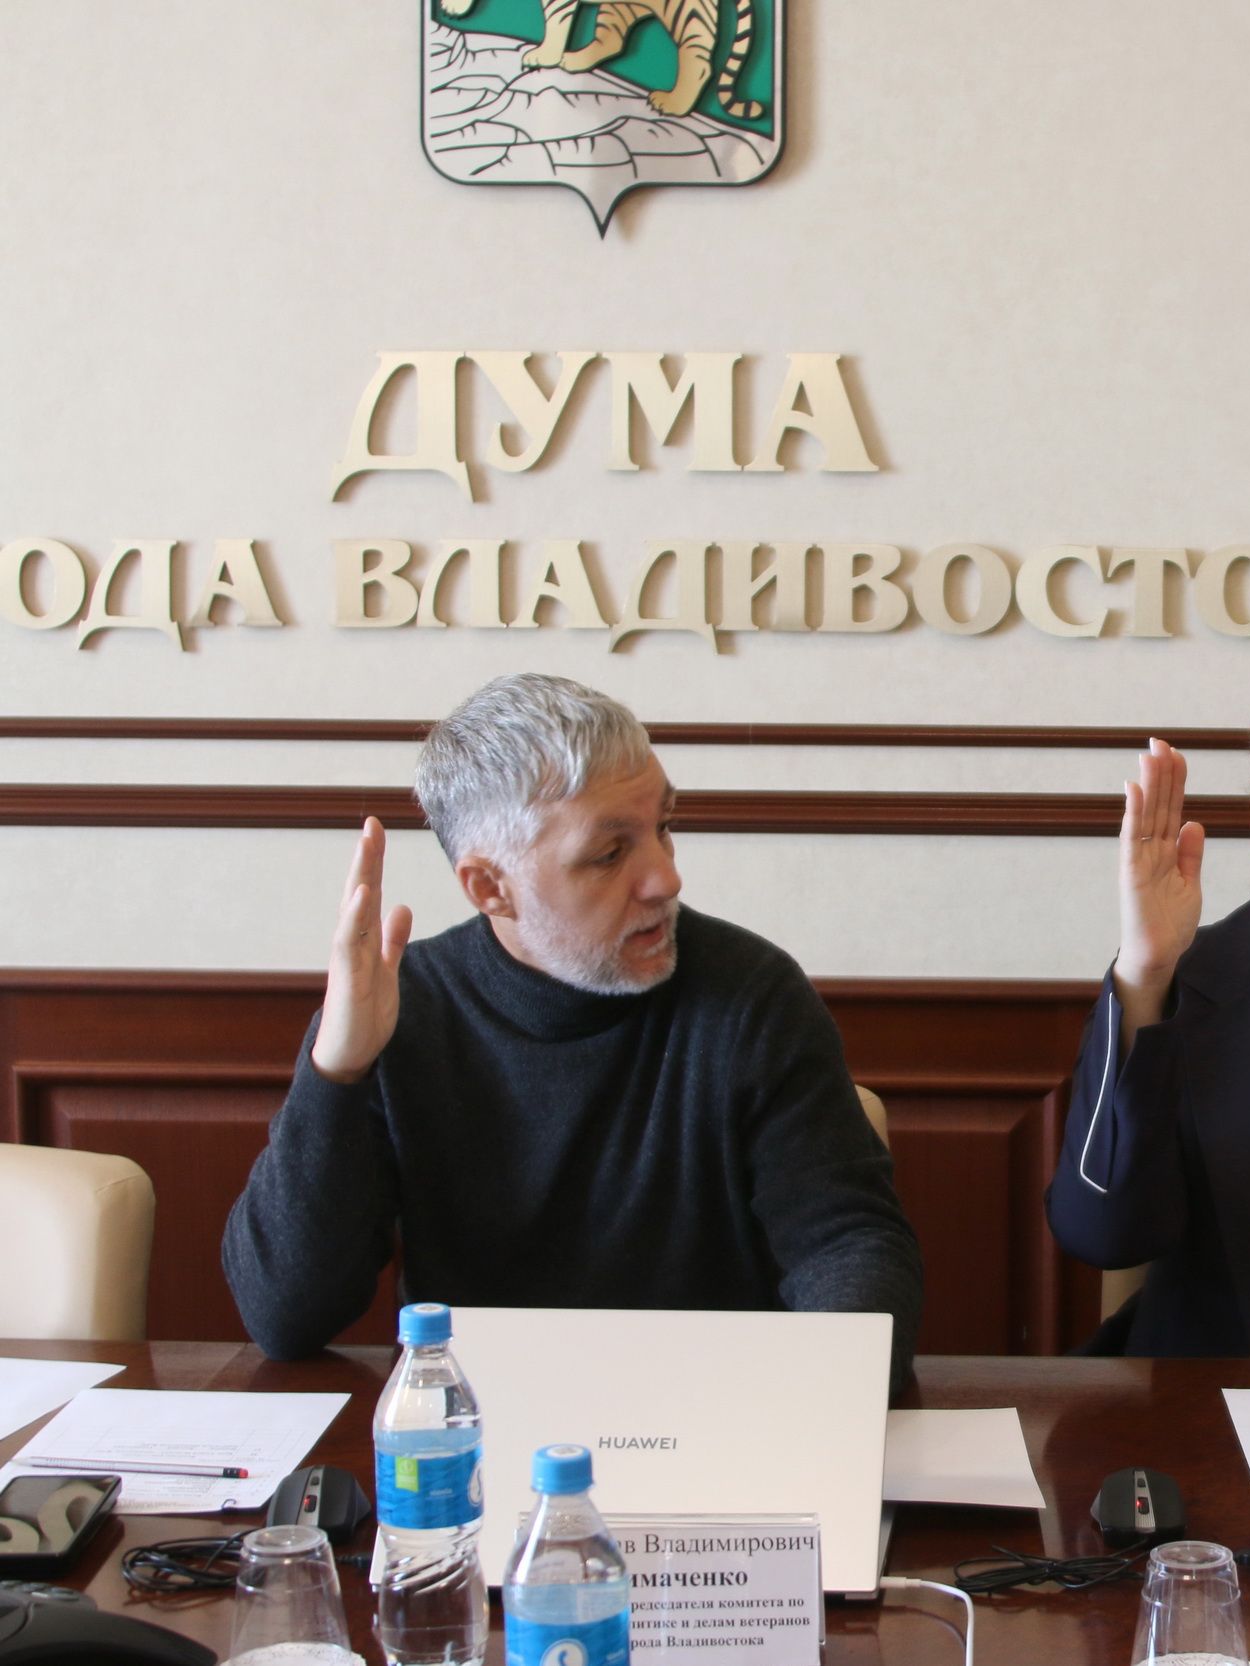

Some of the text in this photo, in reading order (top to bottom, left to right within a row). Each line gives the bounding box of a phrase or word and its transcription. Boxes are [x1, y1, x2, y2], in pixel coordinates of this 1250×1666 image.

[332, 351, 880, 502] ДУМА
[0, 537, 285, 652] ОДА
[598, 1436, 677, 1449] HUAWEI
[644, 1533, 815, 1557] Владимирович
[718, 1598, 784, 1609] комитета
[788, 1598, 805, 1607] по
[681, 1619, 689, 1628] и
[693, 1618, 735, 1629] делам
[739, 1616, 810, 1629] ветеранов
[667, 1635, 765, 1648] Владивостока
